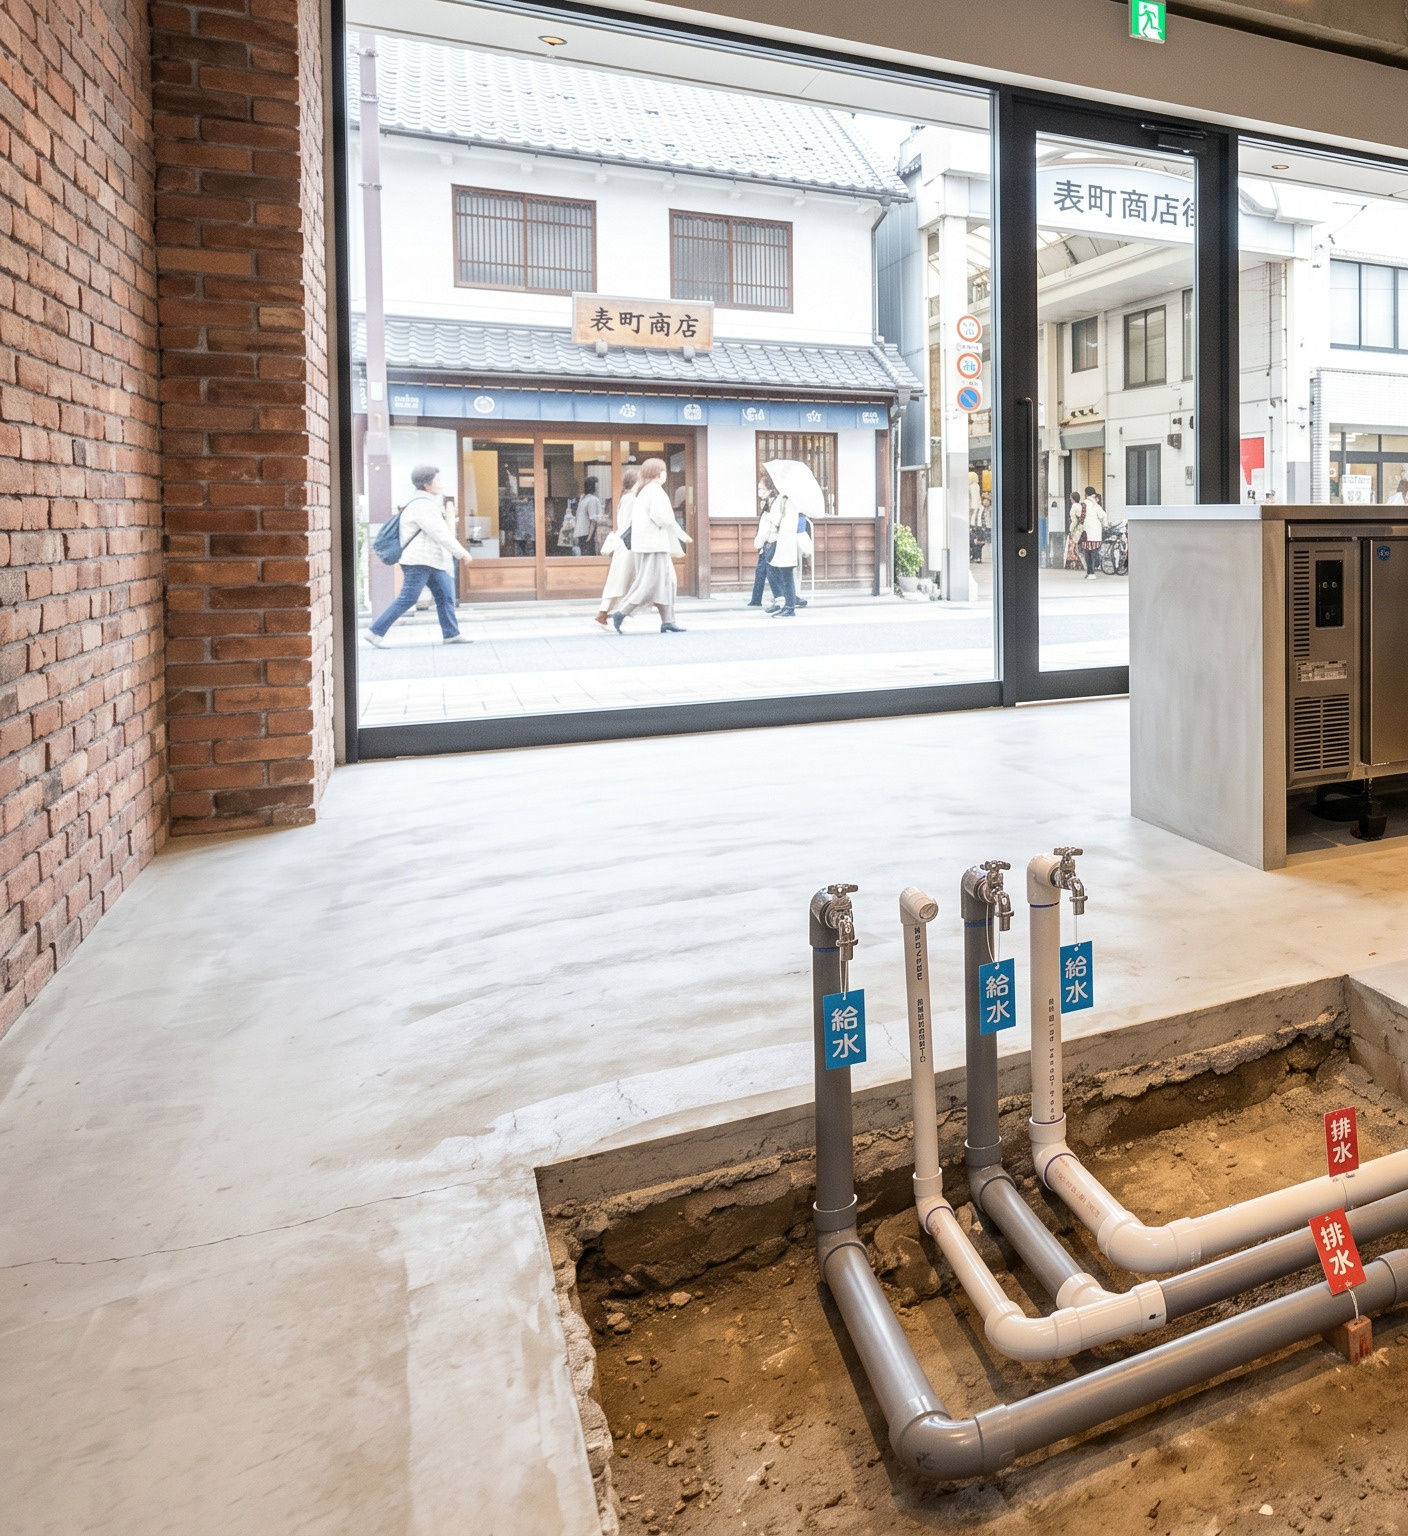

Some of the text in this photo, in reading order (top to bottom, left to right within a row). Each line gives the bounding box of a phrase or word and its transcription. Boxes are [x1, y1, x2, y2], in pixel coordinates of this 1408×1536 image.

[589, 306, 699, 338] 表町商店
[985, 973, 1011, 1025] 給水
[1064, 955, 1089, 1004] 給水
[831, 1005, 861, 1059] 給水
[1330, 1117, 1353, 1164] 排水
[1320, 1221, 1355, 1276] 排水
